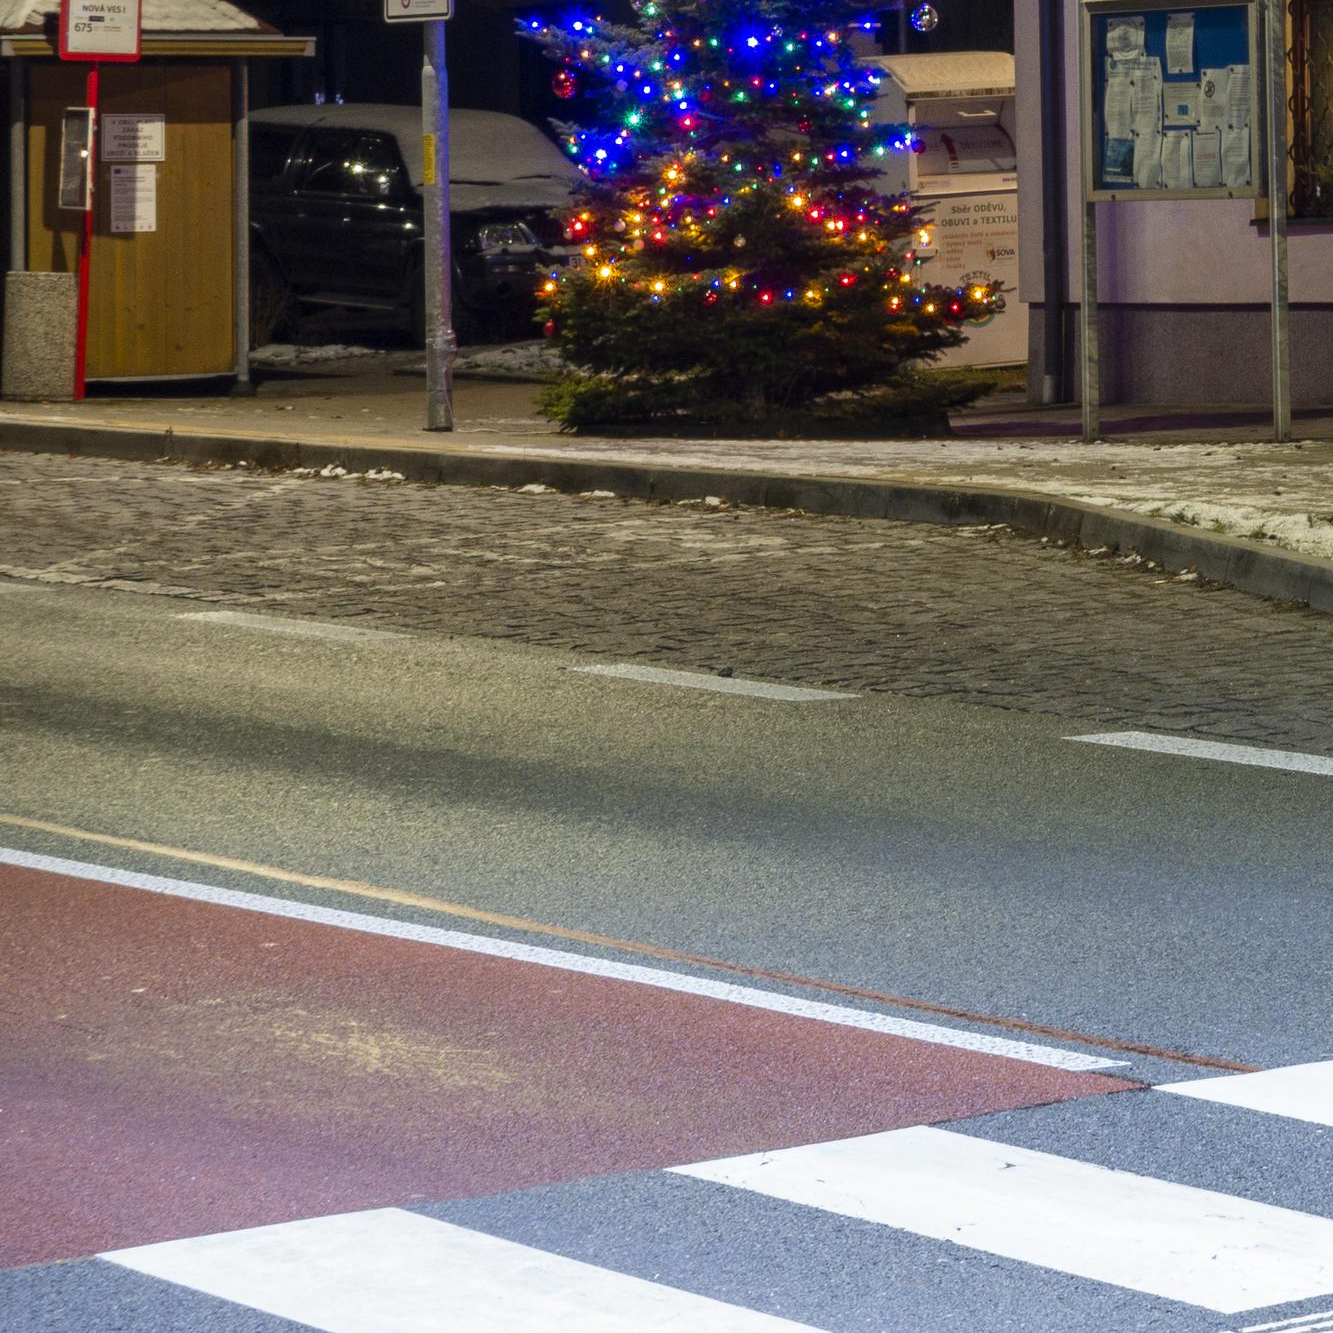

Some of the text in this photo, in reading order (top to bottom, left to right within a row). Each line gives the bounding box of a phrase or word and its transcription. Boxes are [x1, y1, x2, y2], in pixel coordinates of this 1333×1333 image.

[82, 3, 105, 12] NOVÁ
[107, 5, 122, 13] VES
[74, 22, 93, 33] 675
[951, 205, 971, 214] Sběr
[941, 218, 970, 228] OBUVI
[980, 215, 1018, 225] TEXTILU
[996, 249, 1015, 257] SOVA
